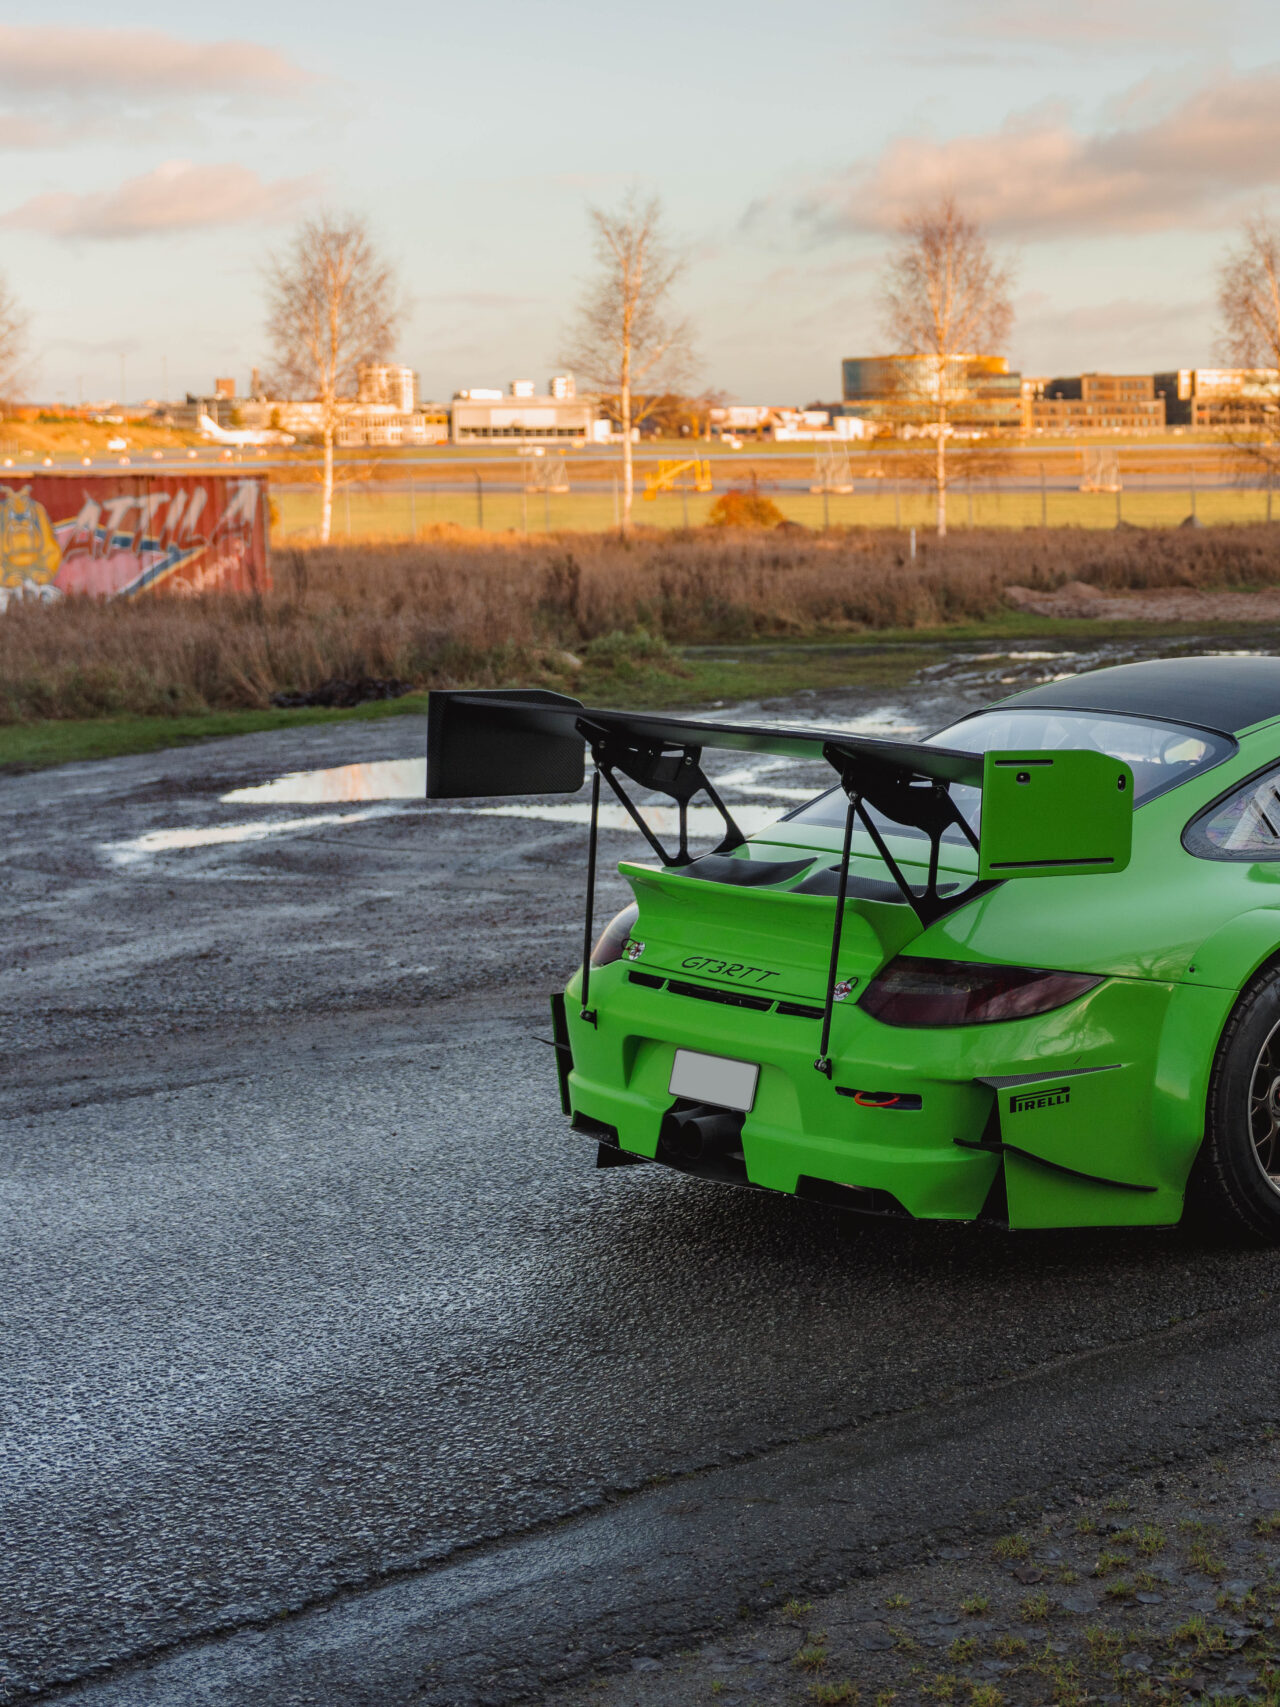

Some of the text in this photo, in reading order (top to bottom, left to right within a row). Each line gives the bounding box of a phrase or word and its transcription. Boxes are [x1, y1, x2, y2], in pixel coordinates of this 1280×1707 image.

[62, 480, 260, 563] ATTILA
[681, 956, 780, 983] GT3RTT
[1009, 1086, 1071, 1114] PIRELLI
